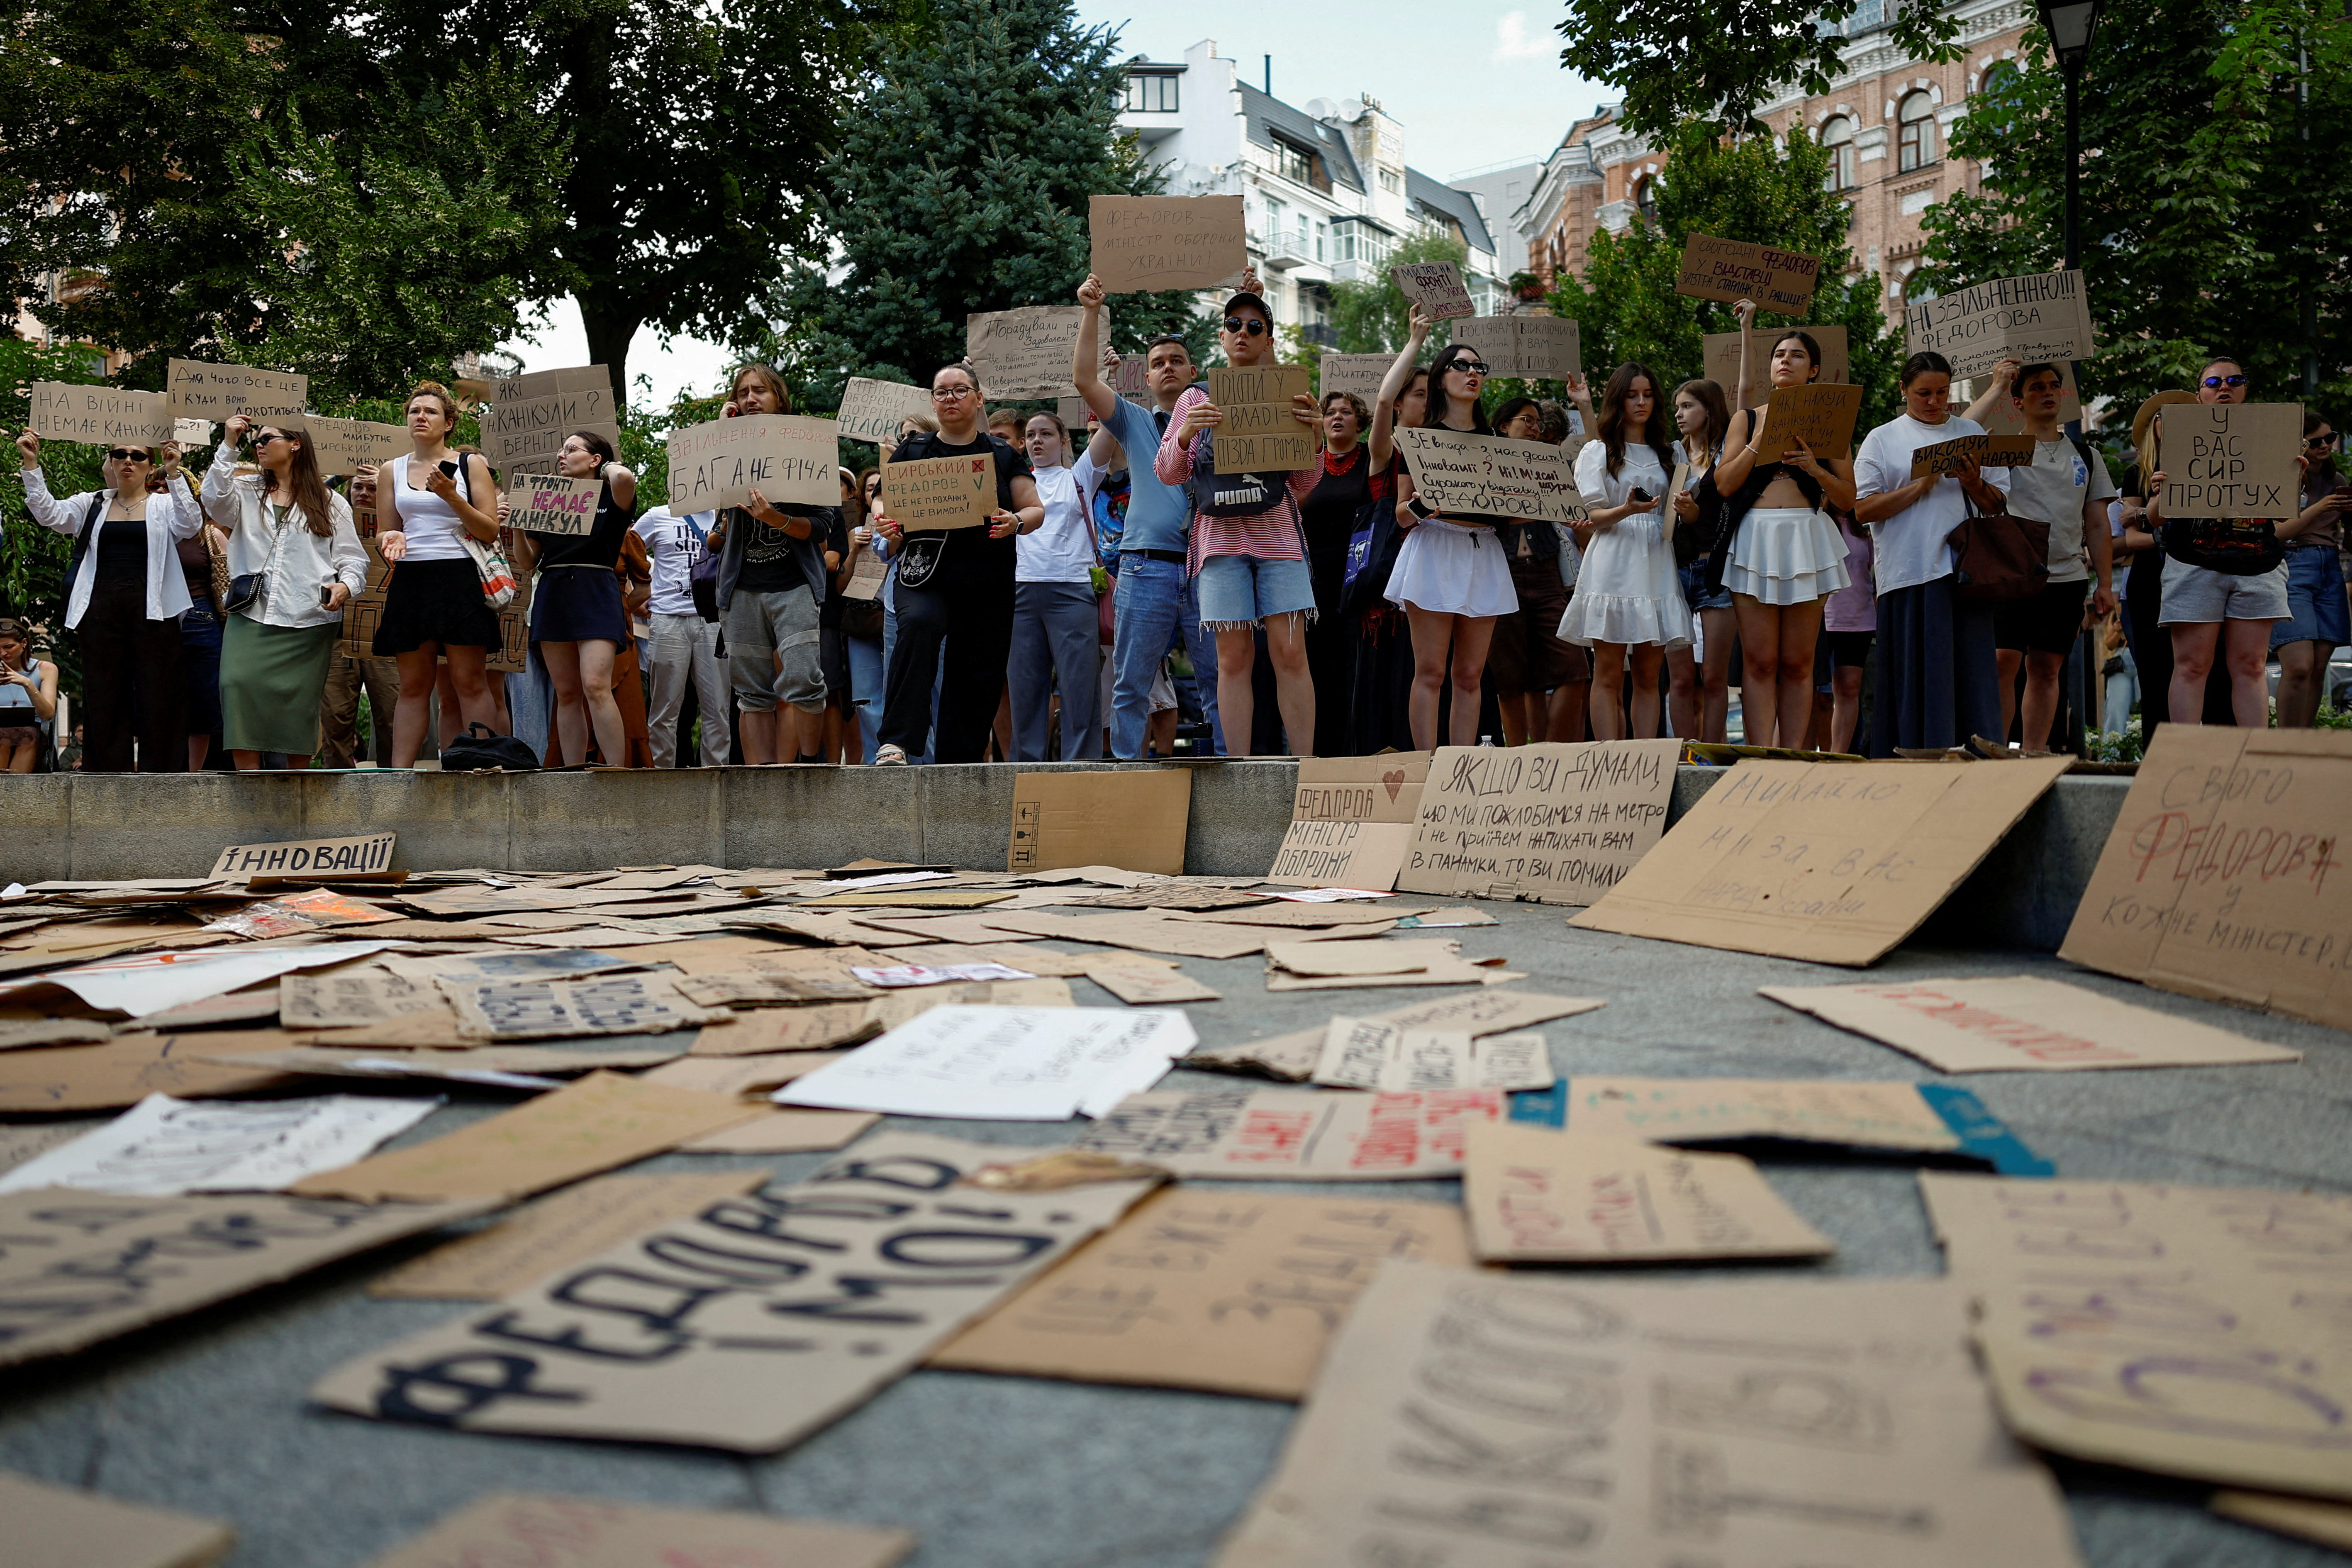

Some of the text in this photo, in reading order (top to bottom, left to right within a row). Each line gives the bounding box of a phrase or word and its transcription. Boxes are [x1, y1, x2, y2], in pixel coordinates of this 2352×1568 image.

[1107, 210, 1193, 229] ФЕДОРОВ
[1103, 234, 1236, 249] МІНІСТР ОБОРОНИ
[1127, 250, 1211, 271] УКРАЇНИ!
[1699, 240, 1816, 275] СЬОГОДНІ ФЕДОРОВ
[1401, 264, 1451, 280] МІЙ ТАТО НА
[1416, 273, 1452, 289] ФРОНТІ
[1696, 258, 1773, 286] У ВІДСТАВЦІ
[1416, 286, 1467, 306] Я ТУТ ЗЛЮСЯ
[1679, 272, 1807, 306] ЗАВТРА СТАРЛІНК В РАШЦІ?
[1430, 300, 1472, 315] ЗАМІСТЬ НЬОГО
[1909, 272, 2075, 335] НІ ЗВІЛЬНЕННЮ!!!
[985, 317, 1057, 342] Порадували
[1460, 322, 1514, 337] РОСІЯНАМ
[1922, 307, 2041, 351] ФЕДОРОВА
[1475, 338, 1550, 350] starlink А ВАМ
[988, 353, 999, 365] Це
[1006, 354, 1024, 363] війна
[995, 361, 1038, 372] гарматного
[175, 367, 298, 391] Для ВСЕ ЦЕ
[500, 379, 521, 400] ЯКІ
[848, 379, 928, 401] МІНІСТЕРС
[986, 376, 1027, 387] Поверніть
[1277, 373, 1284, 398] У
[39, 392, 143, 414] НА ВІЙНІ
[846, 392, 905, 410] ОБОРОНИ
[990, 387, 1024, 397] Сирського
[1777, 391, 1796, 414] ЯКІ
[1803, 390, 1846, 408] НАХУЙ
[314, 419, 370, 432] ФЕДОРОВ
[498, 398, 575, 432] КАНІКУЛИ
[1772, 415, 1820, 431] КАНІКУЛИ
[2209, 408, 2228, 433] У
[38, 415, 97, 432] НЕМАЄ
[104, 419, 171, 439] КАНІКУЛ
[343, 432, 392, 443] МАЙБУТНЄ
[1768, 433, 1781, 445] ВИ
[1819, 428, 1833, 439] ЧИ
[313, 442, 370, 453] СИРСЬКИЙ
[673, 427, 837, 460] ЗВІЛЬНЕННЯ ФЕДОРОВА
[1915, 436, 1989, 464] ВИКОНУЙ
[2194, 436, 2242, 457] ВАС
[888, 458, 964, 480] СИРСЬКИЙ
[1982, 450, 2033, 466] НАРОДУ
[732, 458, 743, 486] А
[751, 457, 774, 483] НЕ
[782, 458, 828, 480] ФІЧА
[2189, 459, 2244, 480] СИР
[513, 475, 574, 492] НА ФРОНТІ
[888, 478, 958, 495] ФЕДОРОВ
[531, 491, 594, 513] НЕМАЄ
[893, 499, 907, 508] ЦЕ
[926, 494, 967, 504] ПРОХАННЯ
[1215, 487, 1262, 505] PUMA
[1423, 489, 1588, 520] ФЕДОРОВА МО
[2169, 484, 2281, 507] ПРОТУХ
[508, 509, 582, 533] КАНІКУЛ
[913, 502, 969, 518] ЦЕ ВИМОГА!
[1441, 750, 1660, 796] ЯКЩО ВИ ДУМАЛИ,
[2162, 765, 2294, 809] СВОГО
[1299, 789, 1373, 820] ФЕДОРОВ
[1452, 806, 1477, 825] МИ
[1480, 803, 1582, 827] ПОЖЛОБИМСЯ
[1588, 803, 1610, 824] НА
[1287, 820, 1360, 846] МІНІСТР
[1528, 832, 1597, 850] НАПИХАТИ
[1600, 832, 1633, 850] ВАМ
[222, 836, 392, 872] ІННОВАЦІЇ
[1275, 849, 1353, 878] ОБОРОНИ
[2130, 812, 2342, 897] ФЕДОРОВА
[1411, 851, 1424, 869] В
[1528, 858, 1551, 877] ВИ
[1557, 860, 1629, 889] ПОМИЛИ
[2102, 896, 2199, 934] КОЖНЕ
